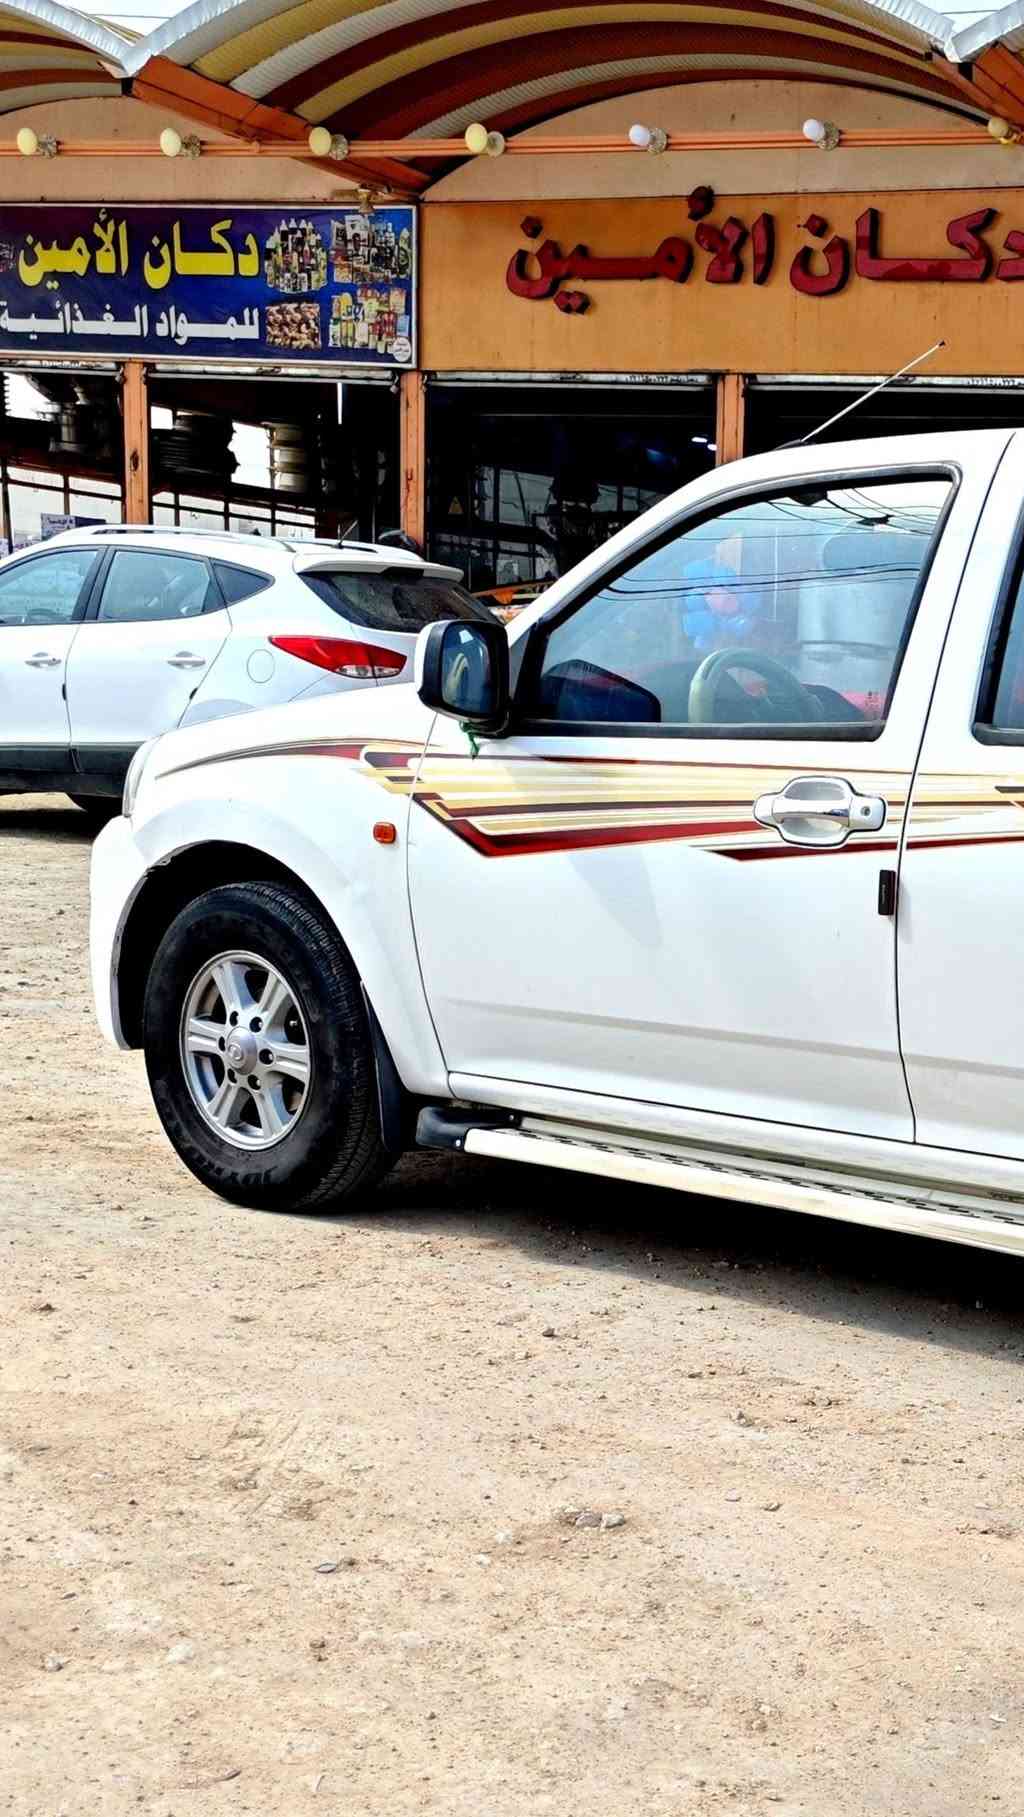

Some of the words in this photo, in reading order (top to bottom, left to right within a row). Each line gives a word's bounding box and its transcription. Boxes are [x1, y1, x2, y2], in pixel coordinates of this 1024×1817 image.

[18, 208, 129, 289] الأمين
[143, 219, 259, 289] دكان
[506, 186, 775, 314] الأمين
[0, 300, 149, 341] الغذائية
[155, 305, 260, 346] للمواد
